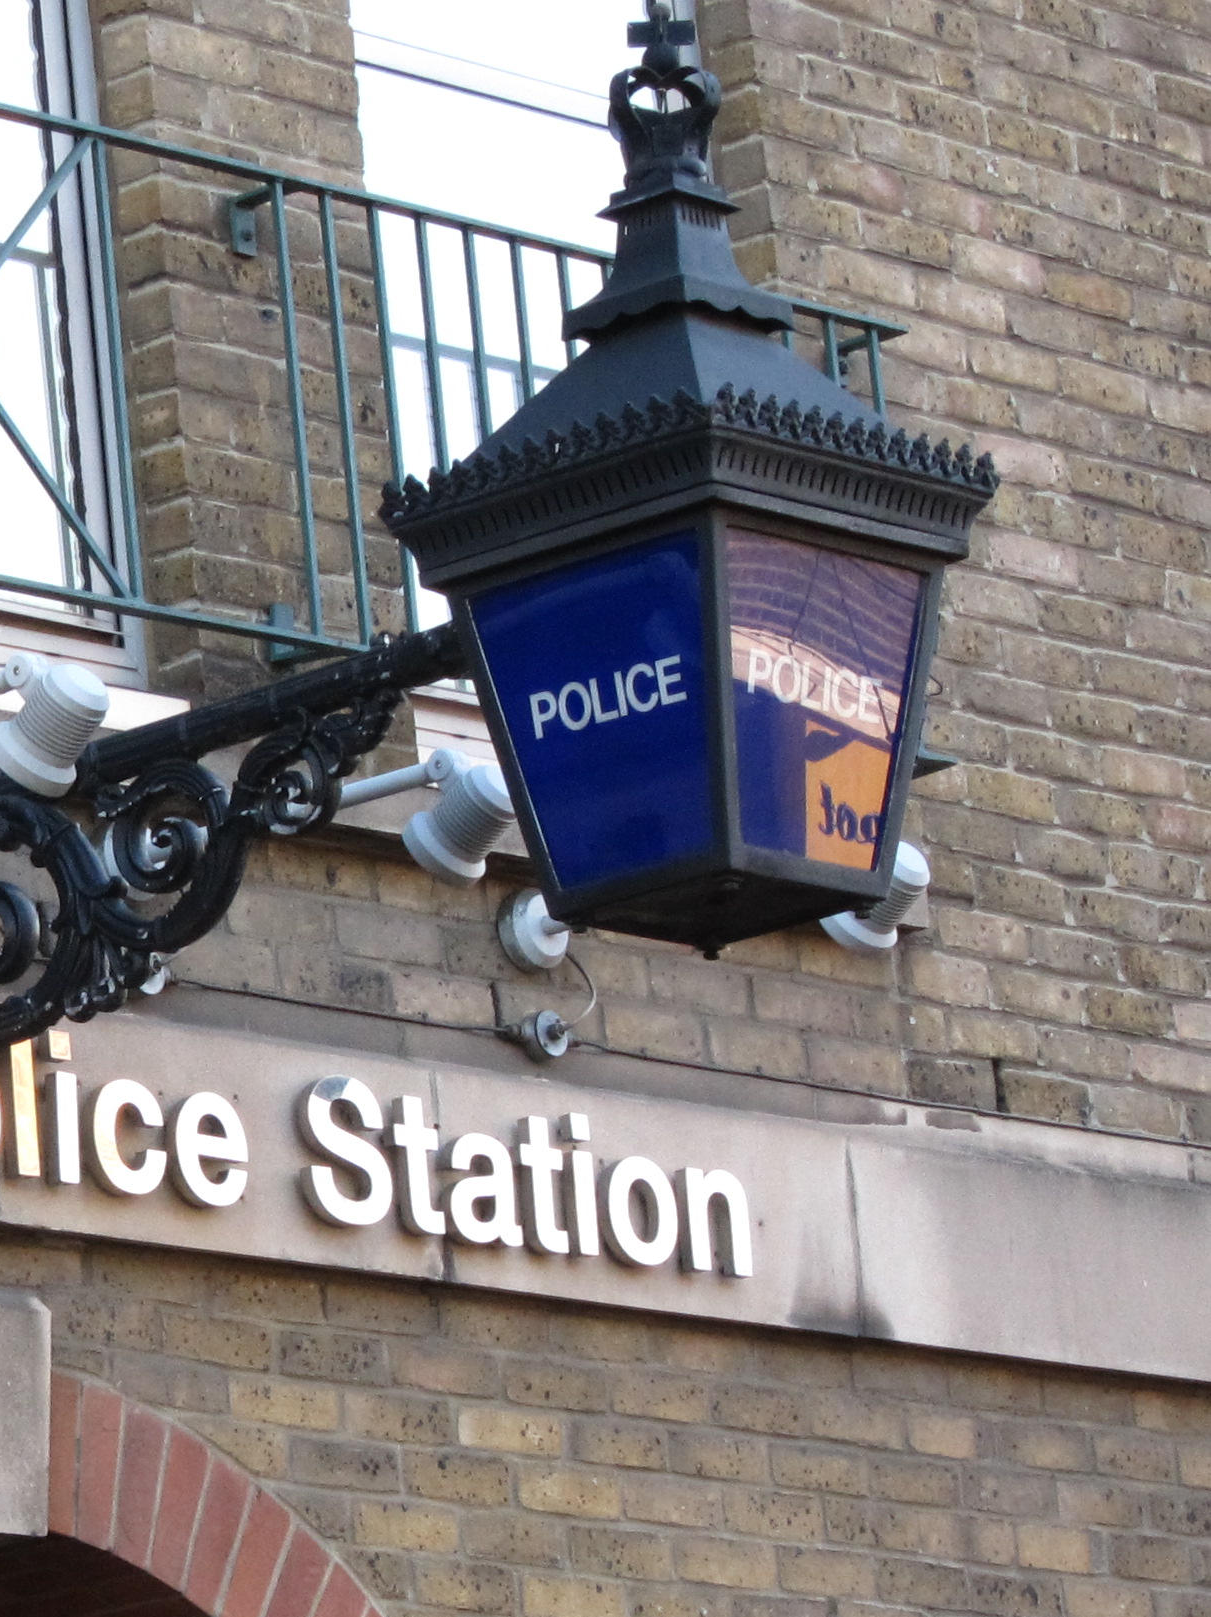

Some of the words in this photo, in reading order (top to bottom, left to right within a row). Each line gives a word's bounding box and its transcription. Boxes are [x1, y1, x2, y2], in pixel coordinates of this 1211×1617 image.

[529, 655, 688, 740] POLICE
[747, 647, 883, 724] POLICE
[300, 1074, 753, 1278] Station
